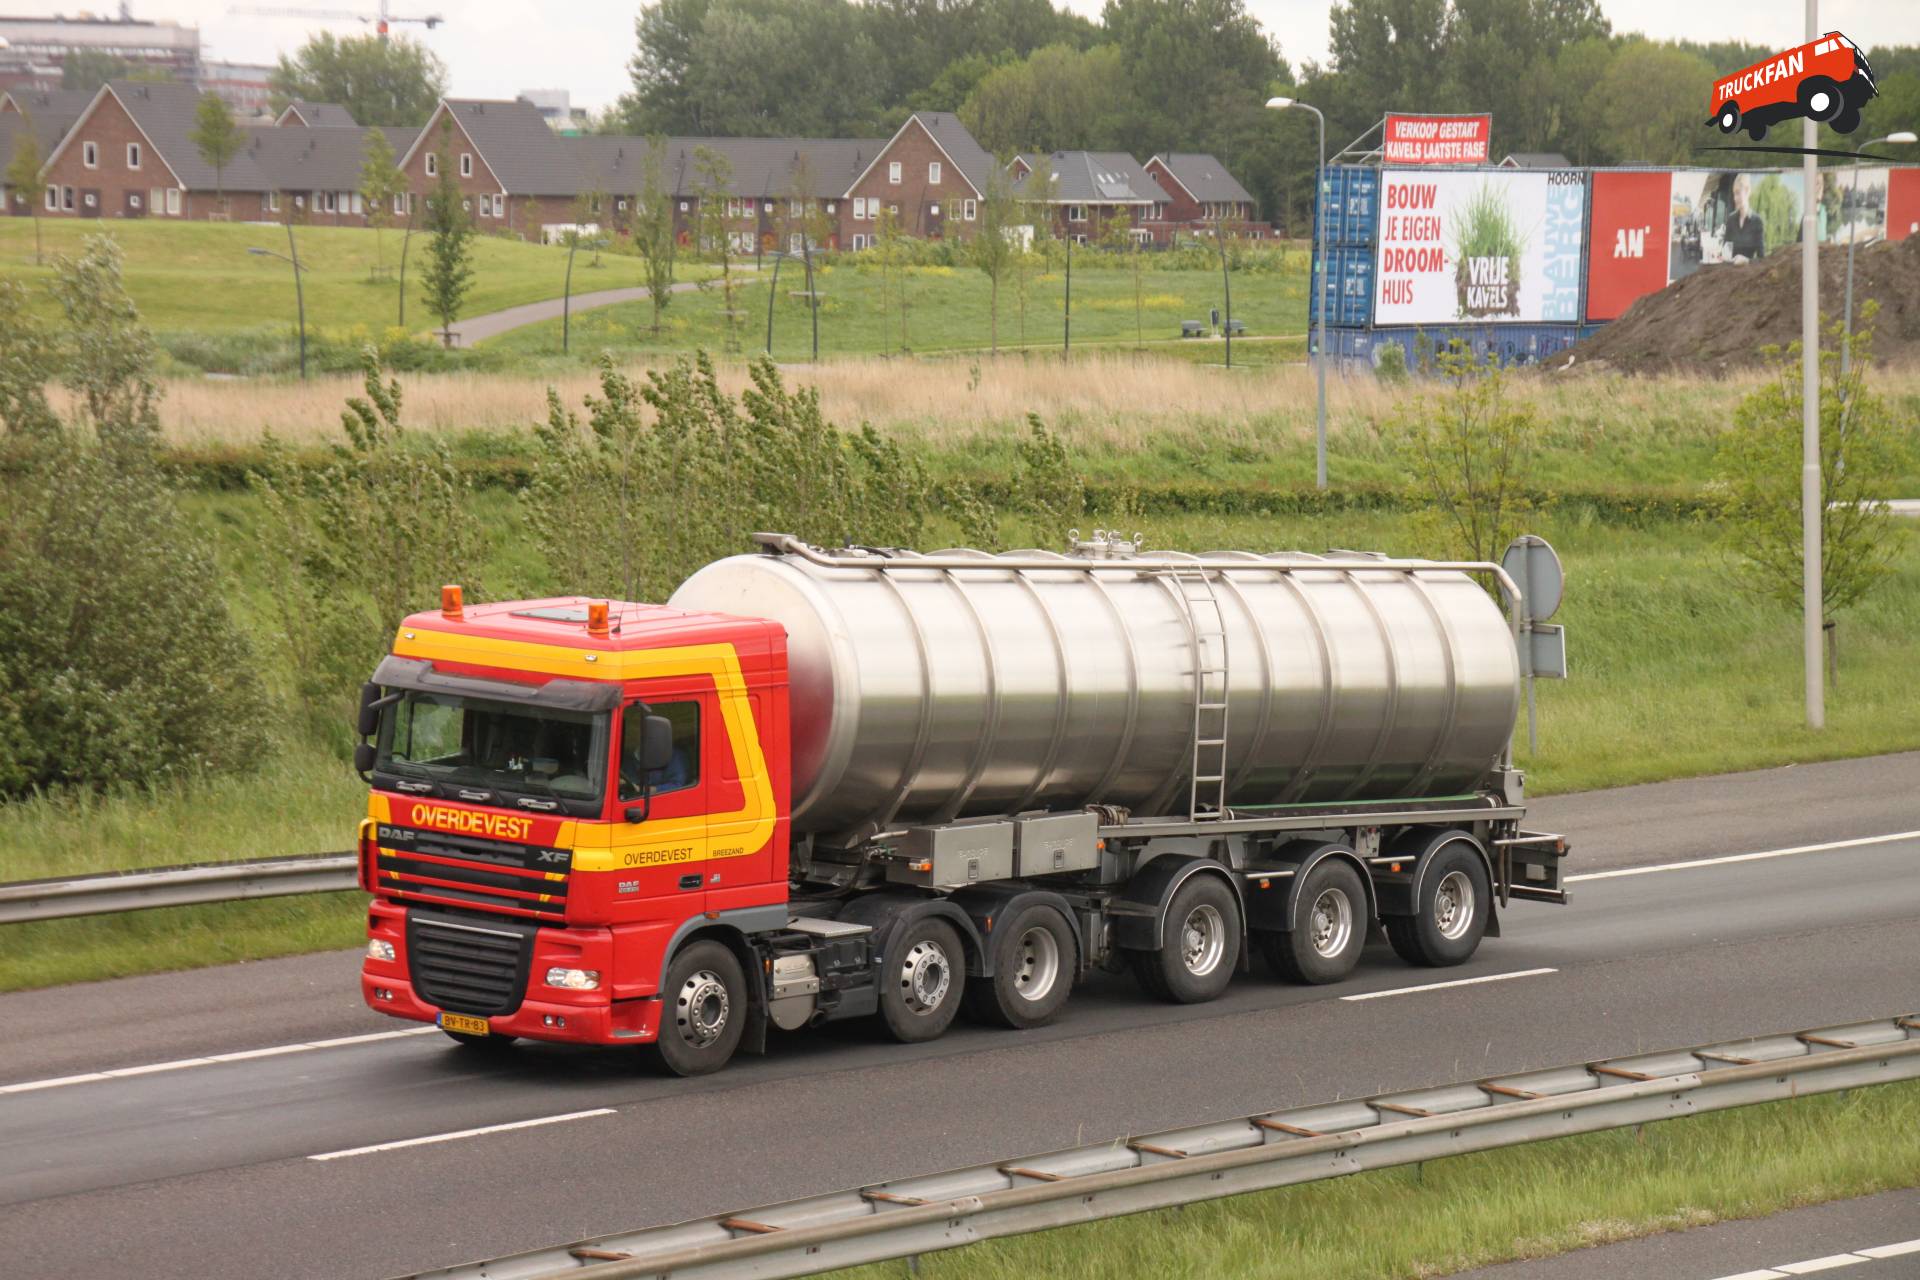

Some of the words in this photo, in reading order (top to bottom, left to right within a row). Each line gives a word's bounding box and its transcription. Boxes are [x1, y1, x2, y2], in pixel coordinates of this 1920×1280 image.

[1395, 121, 1438, 139] VERKOOP
[1440, 121, 1480, 139] GESTART
[1386, 141, 1421, 159] KAVELS
[1424, 141, 1461, 159] LAATSTE
[1463, 141, 1485, 158] FASE
[1547, 172, 1584, 185] HOORN
[1387, 184, 1437, 209] BOUW
[1384, 216, 1398, 240] JE
[1402, 216, 1441, 241] EIGEN
[1383, 248, 1448, 272] DROOM-
[1468, 256, 1509, 285] VRIJE
[1382, 279, 1413, 304] HUIS
[1467, 286, 1508, 308] KAVELS
[411, 804, 533, 839] OVERDEVEST
[379, 827, 415, 840] DAF
[537, 850, 570, 862] XF
[624, 847, 693, 866] OVERDEVEST
[712, 847, 744, 857] BREEZAND
[618, 880, 639, 888] DAF
